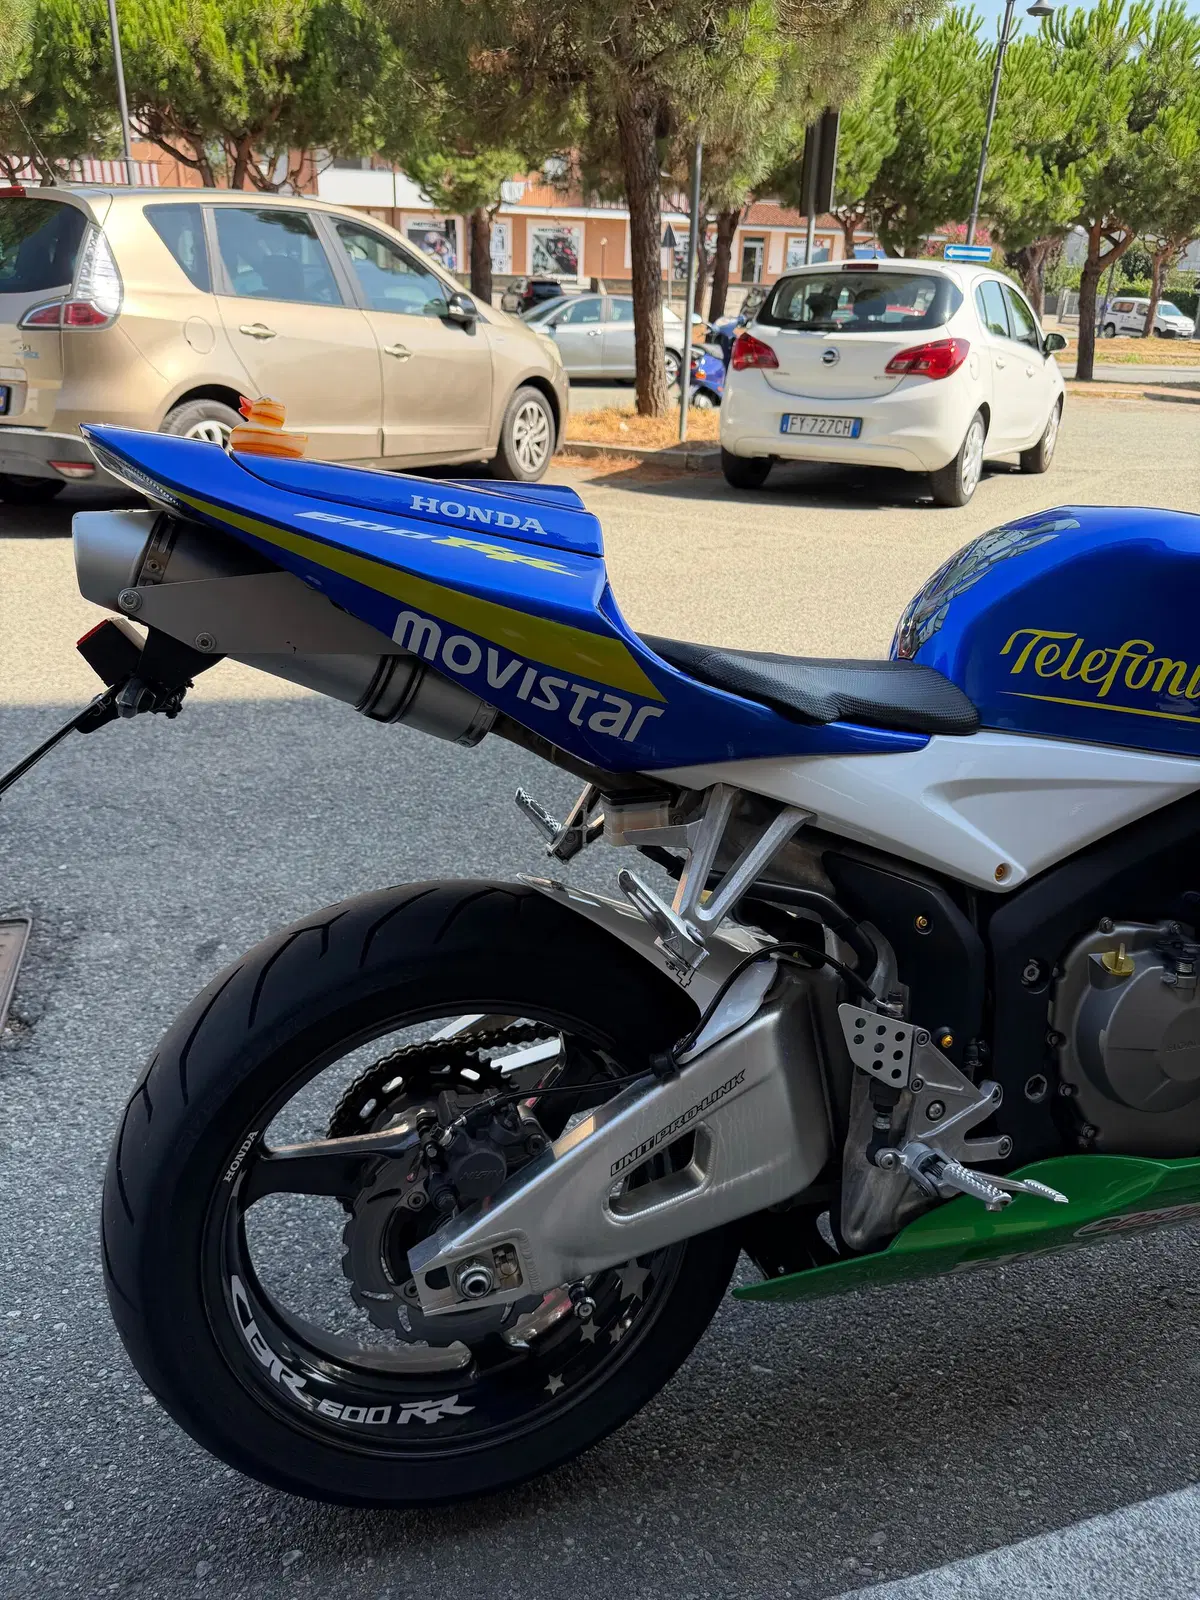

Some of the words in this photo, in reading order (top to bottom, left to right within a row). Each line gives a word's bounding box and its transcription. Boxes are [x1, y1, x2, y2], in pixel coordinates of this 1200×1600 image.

[809, 419, 852, 435] 727CH
[410, 494, 548, 535] HONDA
[392, 610, 665, 742] movistar
[222, 1130, 260, 1182] HONDA
[610, 1135, 656, 1177] UNIT
[655, 1069, 746, 1146] PRO-LINK
[231, 1274, 315, 1402] CBR
[316, 1398, 392, 1425] 600
[396, 1394, 476, 1425] RR
